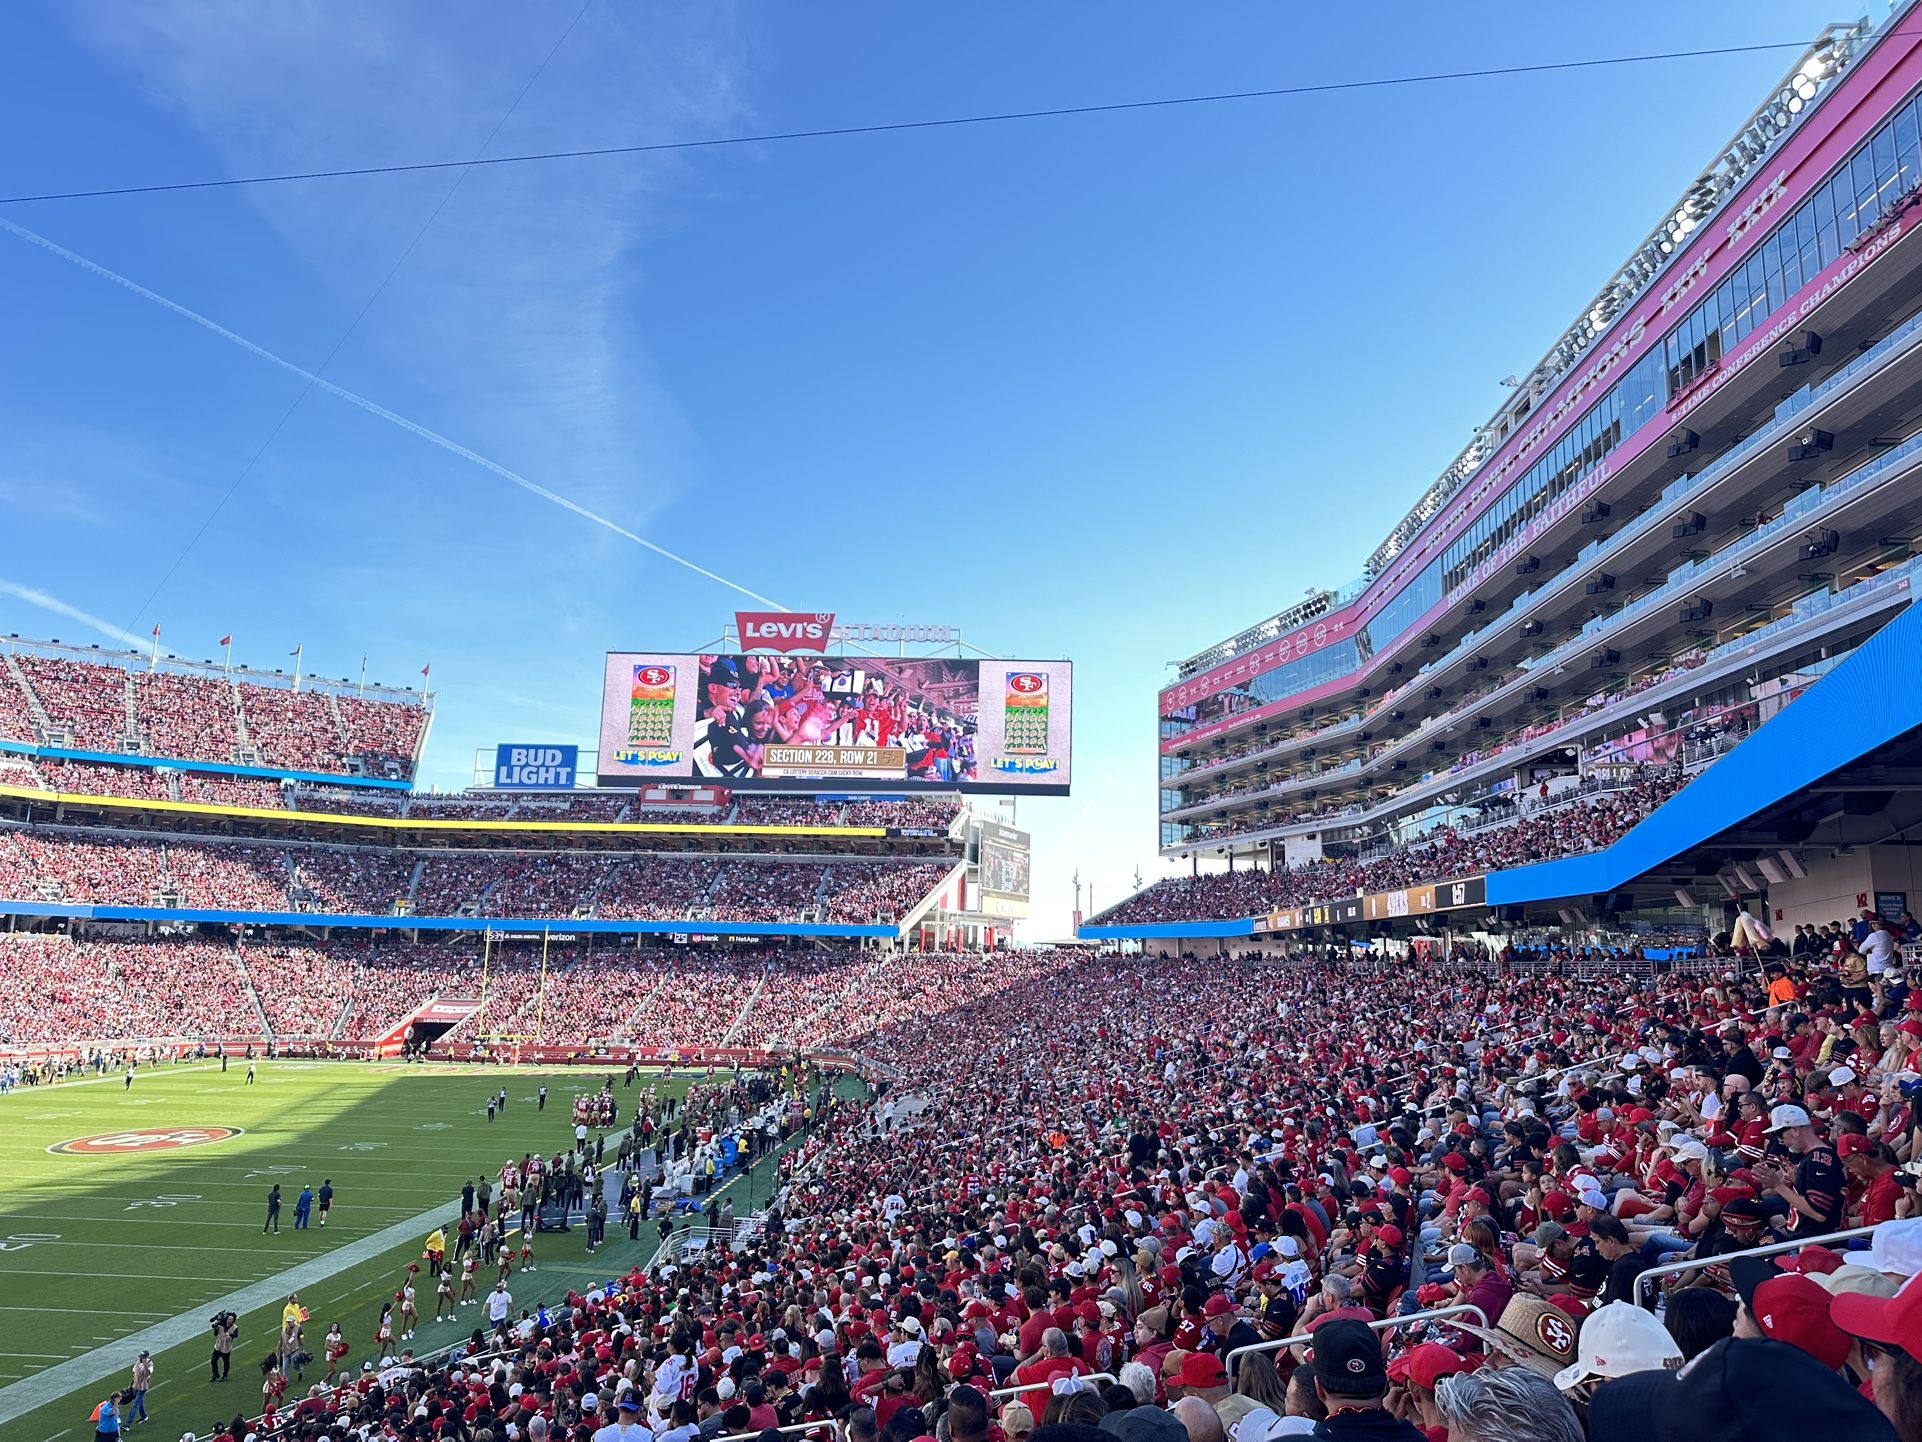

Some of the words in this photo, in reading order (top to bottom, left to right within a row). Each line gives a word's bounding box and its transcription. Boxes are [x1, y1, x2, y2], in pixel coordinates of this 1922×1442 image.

[1671, 386, 1710, 422] 8-TIME
[1712, 311, 1796, 388] CONFERENCE
[1799, 223, 1902, 315] CHAMPIONS
[1470, 453, 1516, 510] BOWL
[1518, 315, 1646, 461] CHAMPIONS
[1446, 571, 1481, 607] HOME
[1481, 558, 1498, 583] OF
[1498, 534, 1529, 566] THE
[1531, 462, 1612, 542] FAITHFUL
[841, 623, 951, 643] STADIUM
[510, 748, 563, 766] BUD
[613, 750, 645, 761] LET'S
[770, 749, 813, 763] SECTION
[815, 750, 837, 765] 228,
[840, 751, 865, 764] ROW
[867, 751, 878, 764] 21
[991, 757, 1023, 769] LET'S
[498, 766, 569, 785] LIGHT
[547, 933, 576, 941] verizon
[890, 1202, 899, 1210] 54
[676, 1373, 695, 1400] 16
